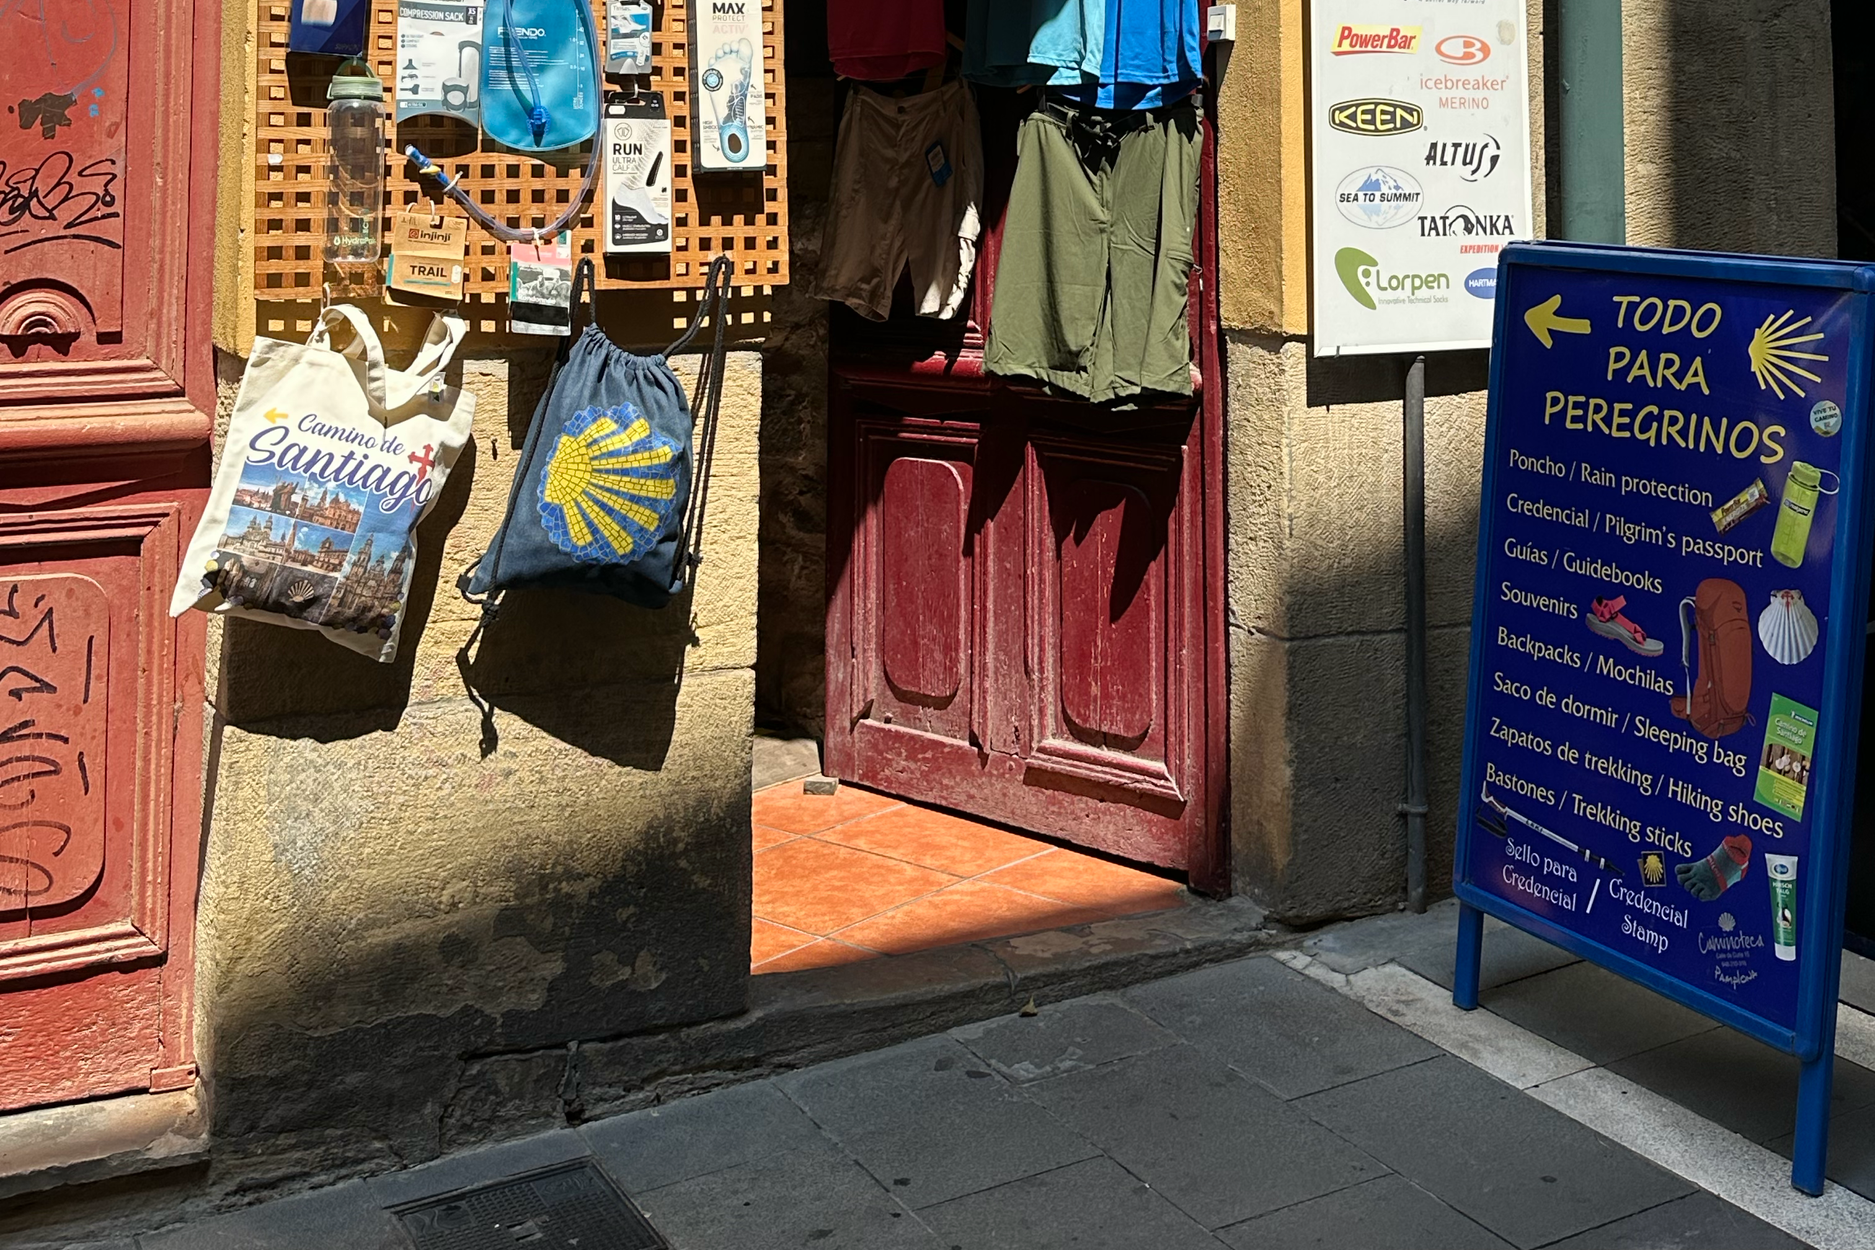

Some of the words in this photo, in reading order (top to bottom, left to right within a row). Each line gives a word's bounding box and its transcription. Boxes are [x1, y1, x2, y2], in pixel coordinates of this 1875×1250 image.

[400, 7, 445, 20] COMPRESSION
[445, 12, 464, 21] SACK
[712, 2, 746, 14] MAX
[712, 14, 746, 22] PROTECT
[497, 26, 545, 37] FENDO
[1337, 25, 1416, 51] PowerBar
[1419, 74, 1507, 92] icebreaker
[1334, 104, 1419, 130] KEEN
[1438, 96, 1489, 110] MERINO
[613, 143, 643, 155] RUN
[1424, 133, 1501, 183] ALTUS
[1339, 192, 1360, 203] SEA
[1363, 192, 1376, 203] TO
[1379, 191, 1421, 204] SUMMIT
[420, 230, 452, 242] injinji
[1460, 244, 1499, 254] EXPEDITION
[410, 265, 447, 278] TRAIL
[1376, 269, 1450, 296] Lorpen
[1407, 295, 1432, 304] Technical
[1433, 295, 1448, 303] Socks
[1612, 295, 1722, 339] TODO
[1607, 346, 1710, 396] PARA
[297, 413, 379, 450] Camino
[380, 434, 406, 457] de
[1544, 391, 1786, 464] PEREGRINOS
[247, 426, 434, 514] Santiago
[1509, 449, 1566, 477] Poncho
[1581, 462, 1615, 488] Rain
[1621, 475, 1712, 508] protection
[1506, 493, 1589, 528] Credencial
[1682, 536, 1764, 568] passport
[1504, 538, 1548, 565] Guías
[1563, 552, 1663, 594] Guidebooks
[1500, 581, 1578, 619] Souvenirs
[1497, 626, 1581, 668] Backpacks
[1596, 654, 1674, 696] Mochilas
[1493, 671, 1531, 700] Saco
[1535, 686, 1557, 709] de
[1561, 694, 1619, 728] dormir
[1633, 716, 1709, 764] Sleeping
[1712, 740, 1747, 777] bag
[1489, 717, 1552, 756] Zapatos
[1557, 741, 1579, 765] de
[1584, 752, 1653, 796] trekking
[1668, 777, 1724, 823] Hiking
[1727, 802, 1784, 839] shoes
[1486, 762, 1555, 806] Bastones
[1572, 793, 1642, 843] Trekking
[1645, 824, 1692, 859] sticks
[1505, 838, 1540, 867] Sello
[1543, 857, 1577, 883] para
[1502, 862, 1577, 912] Credencial
[1609, 878, 1688, 929] Credencial
[1621, 914, 1669, 954] Stamp
[1698, 930, 1764, 954] Caminoteca
